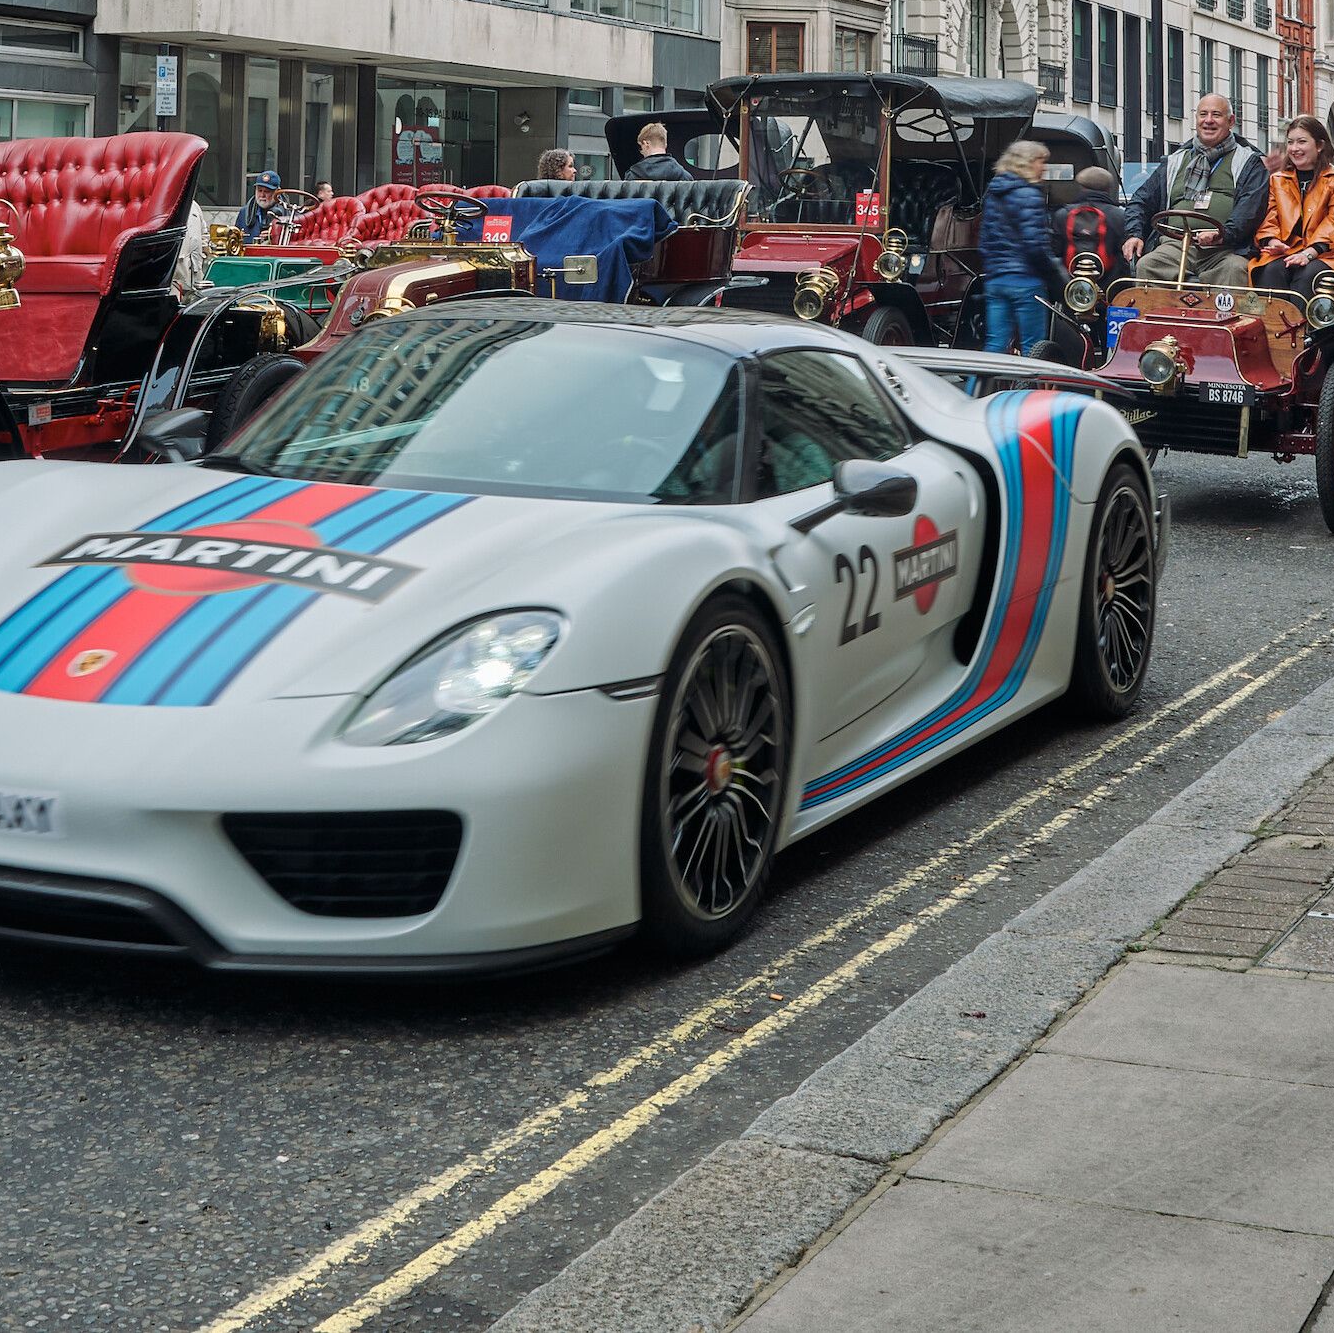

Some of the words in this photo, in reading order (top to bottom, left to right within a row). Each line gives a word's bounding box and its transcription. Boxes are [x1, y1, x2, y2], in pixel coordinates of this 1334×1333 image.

[1217, 297, 1232, 308] NAA
[1207, 382, 1247, 391] MINNESOTA
[1208, 389, 1221, 402] BS
[1222, 390, 1244, 404] 8746
[61, 537, 393, 591] MARTINI
[897, 540, 956, 589] MARTINI
[835, 545, 882, 646] 22
